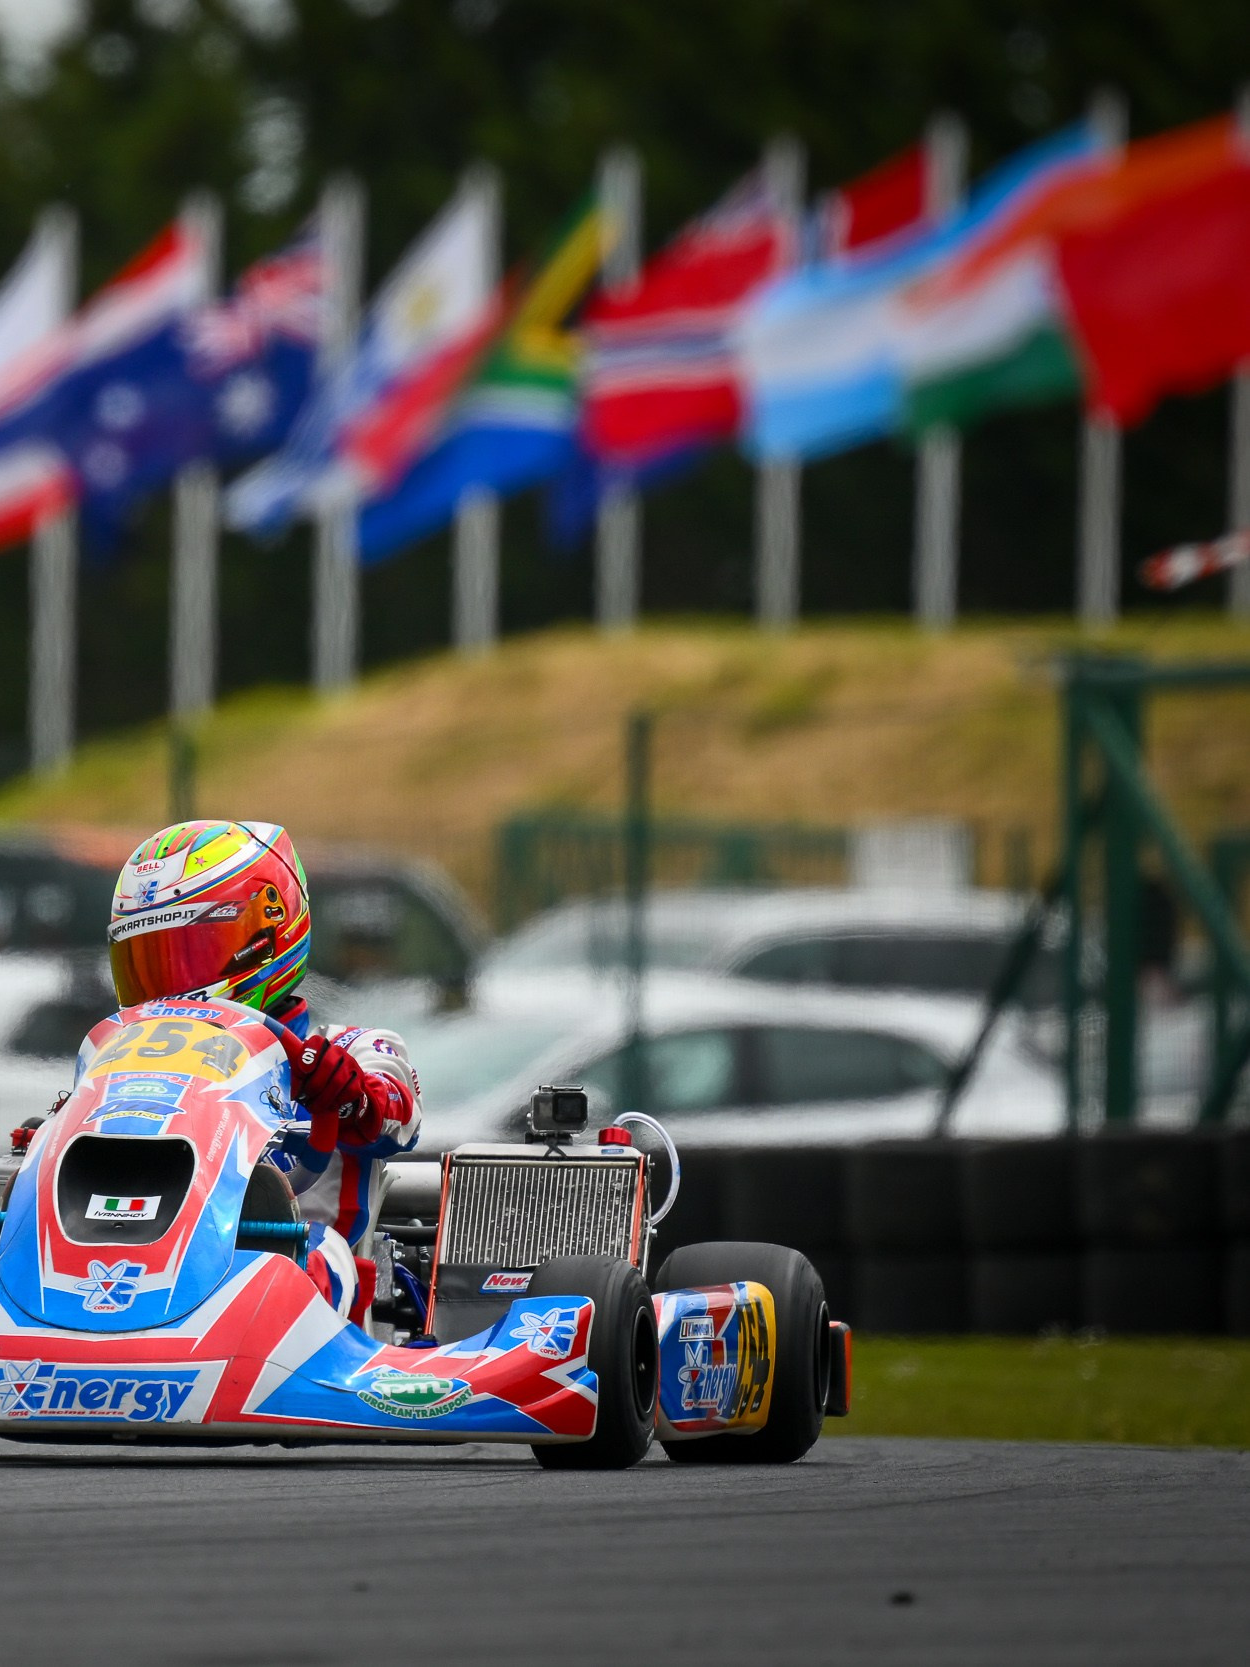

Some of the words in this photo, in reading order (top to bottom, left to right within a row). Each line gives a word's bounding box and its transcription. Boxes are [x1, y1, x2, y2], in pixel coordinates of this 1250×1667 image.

[136, 862, 160, 873] BELL
[146, 1002, 223, 1019] Energy
[89, 1021, 245, 1079] 254
[206, 1107, 231, 1162] energycorse.com
[94, 1210, 148, 1218] IVANNIKOV
[540, 1348, 559, 1356] corse
[12, 1364, 195, 1420] Energy
[358, 1391, 413, 1418] EUROPEAN
[414, 1389, 473, 1418] TRANSPORT
